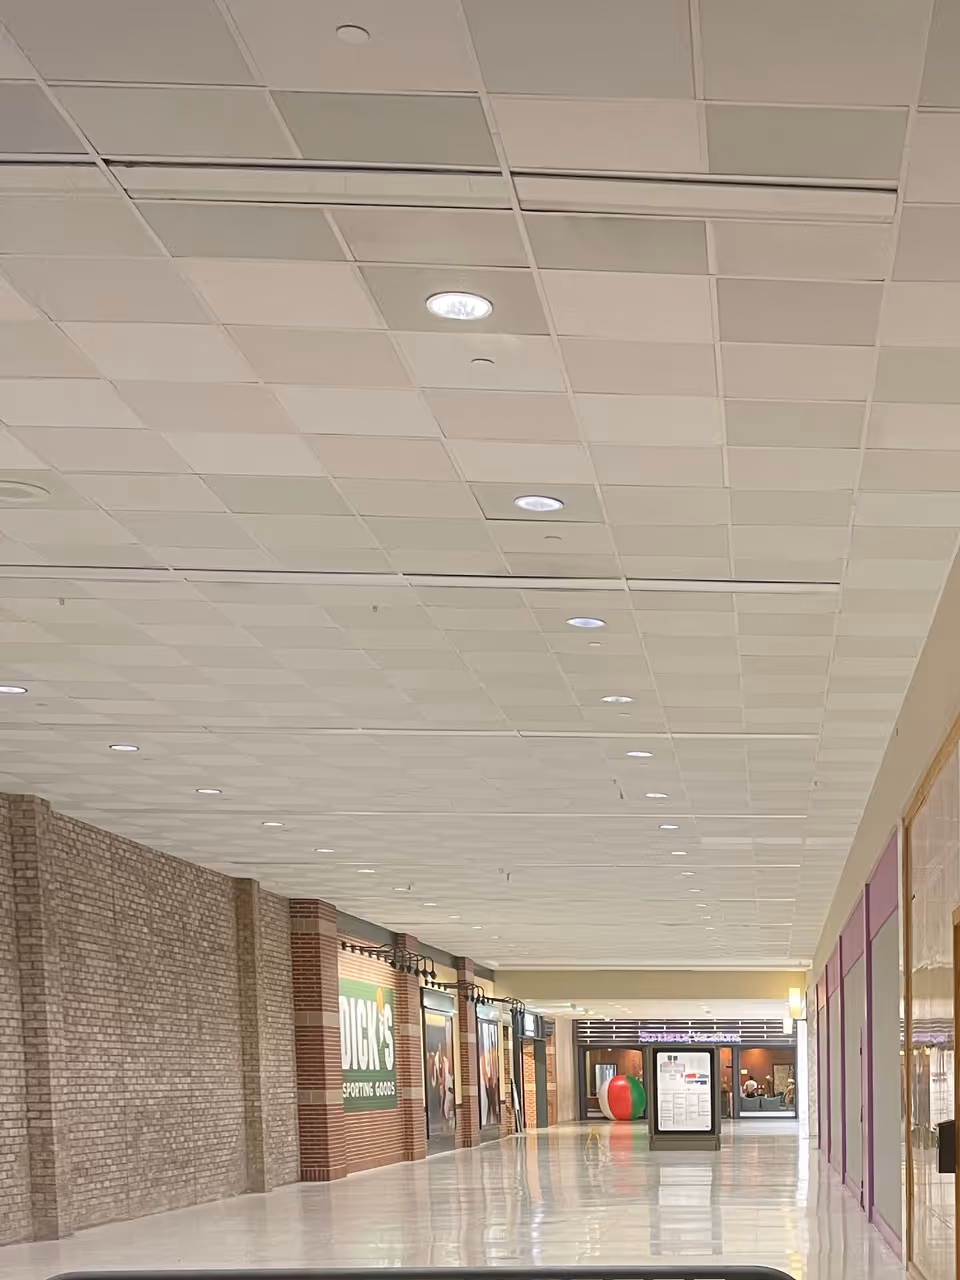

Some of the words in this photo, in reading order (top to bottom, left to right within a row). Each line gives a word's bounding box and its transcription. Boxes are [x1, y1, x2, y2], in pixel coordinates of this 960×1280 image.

[338, 995, 394, 1071] DICK'S
[342, 1082, 374, 1098] SPORTING
[375, 1081, 396, 1097] GOODS
